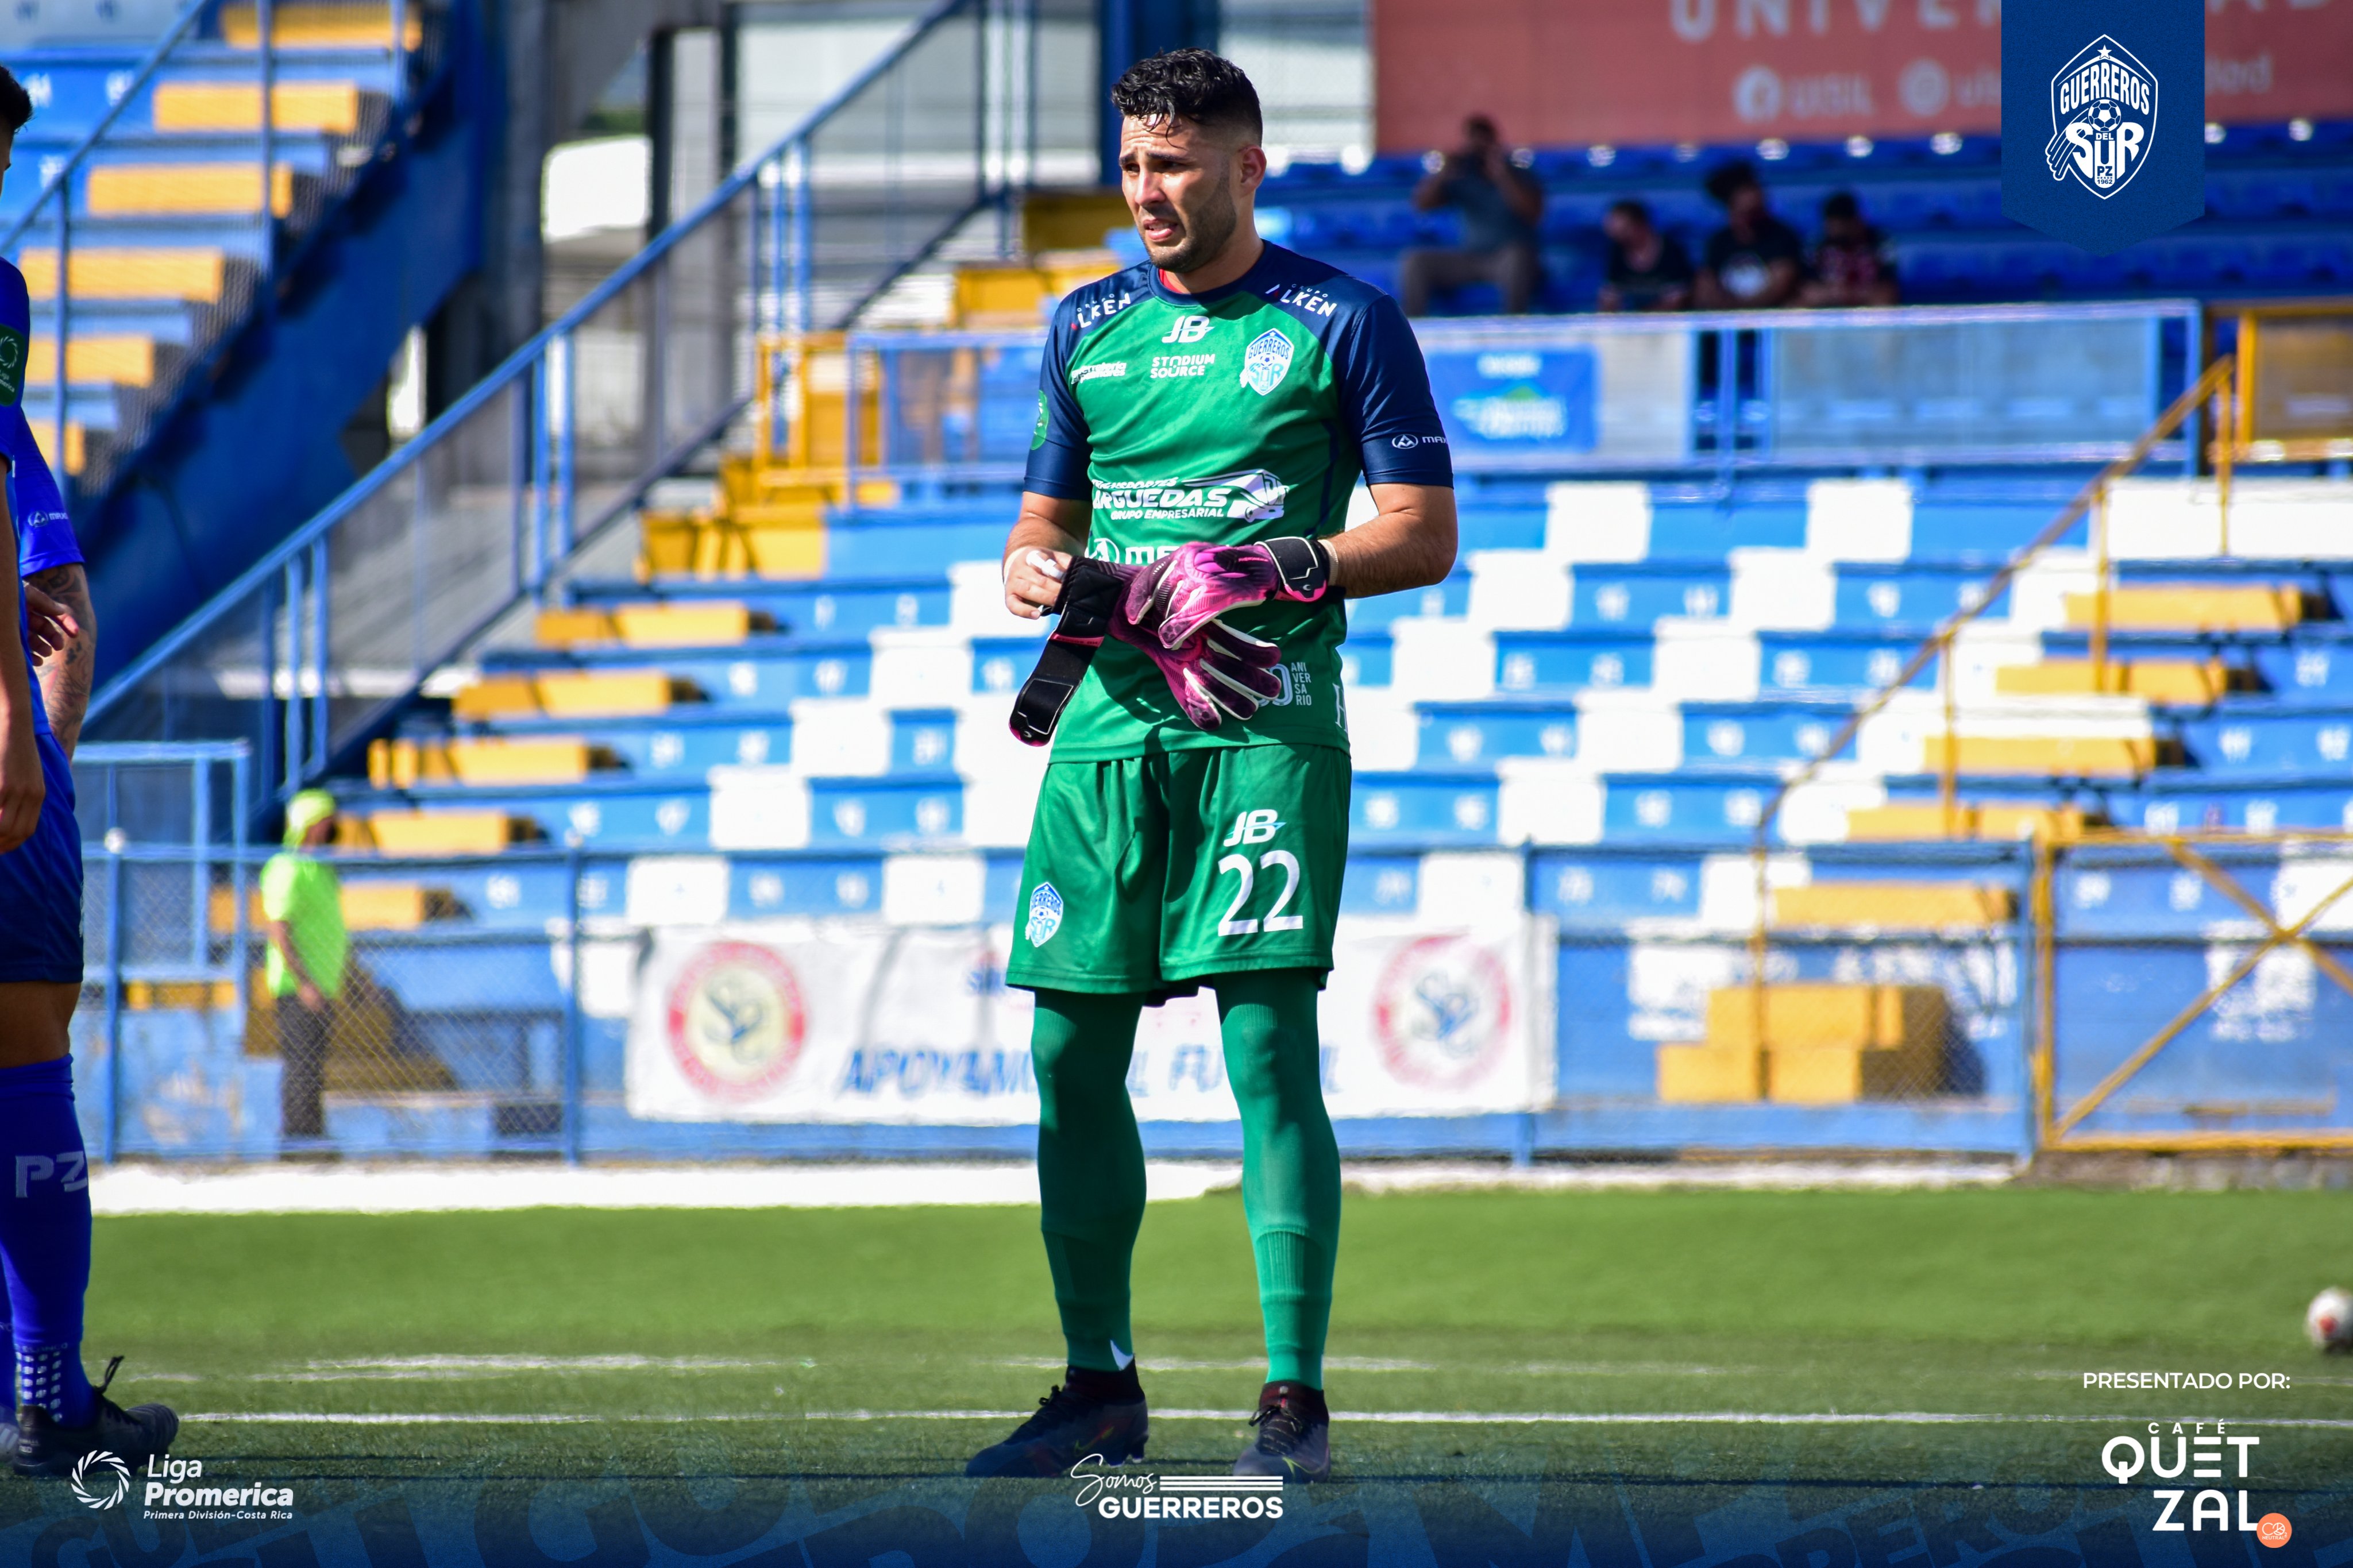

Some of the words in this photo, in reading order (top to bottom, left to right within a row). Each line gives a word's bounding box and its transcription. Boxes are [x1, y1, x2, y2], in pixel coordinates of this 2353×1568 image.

[1162, 315, 1210, 343] JB
[1248, 338, 1289, 360] GUERREROS
[1150, 365, 1206, 379] SOURCE
[1093, 489, 1233, 509] ARGUEDAS
[1110, 509, 1143, 520] GRUPO
[1144, 508, 1224, 519] EMPRESARIAL
[1291, 662, 1307, 672] ANI
[1292, 673, 1311, 683] VER
[1294, 683, 1307, 694] SA
[1296, 694, 1312, 706] RIO
[1223, 809, 1278, 847] JB
[1218, 849, 1303, 937] 22
[15, 1150, 88, 1198] PZ
